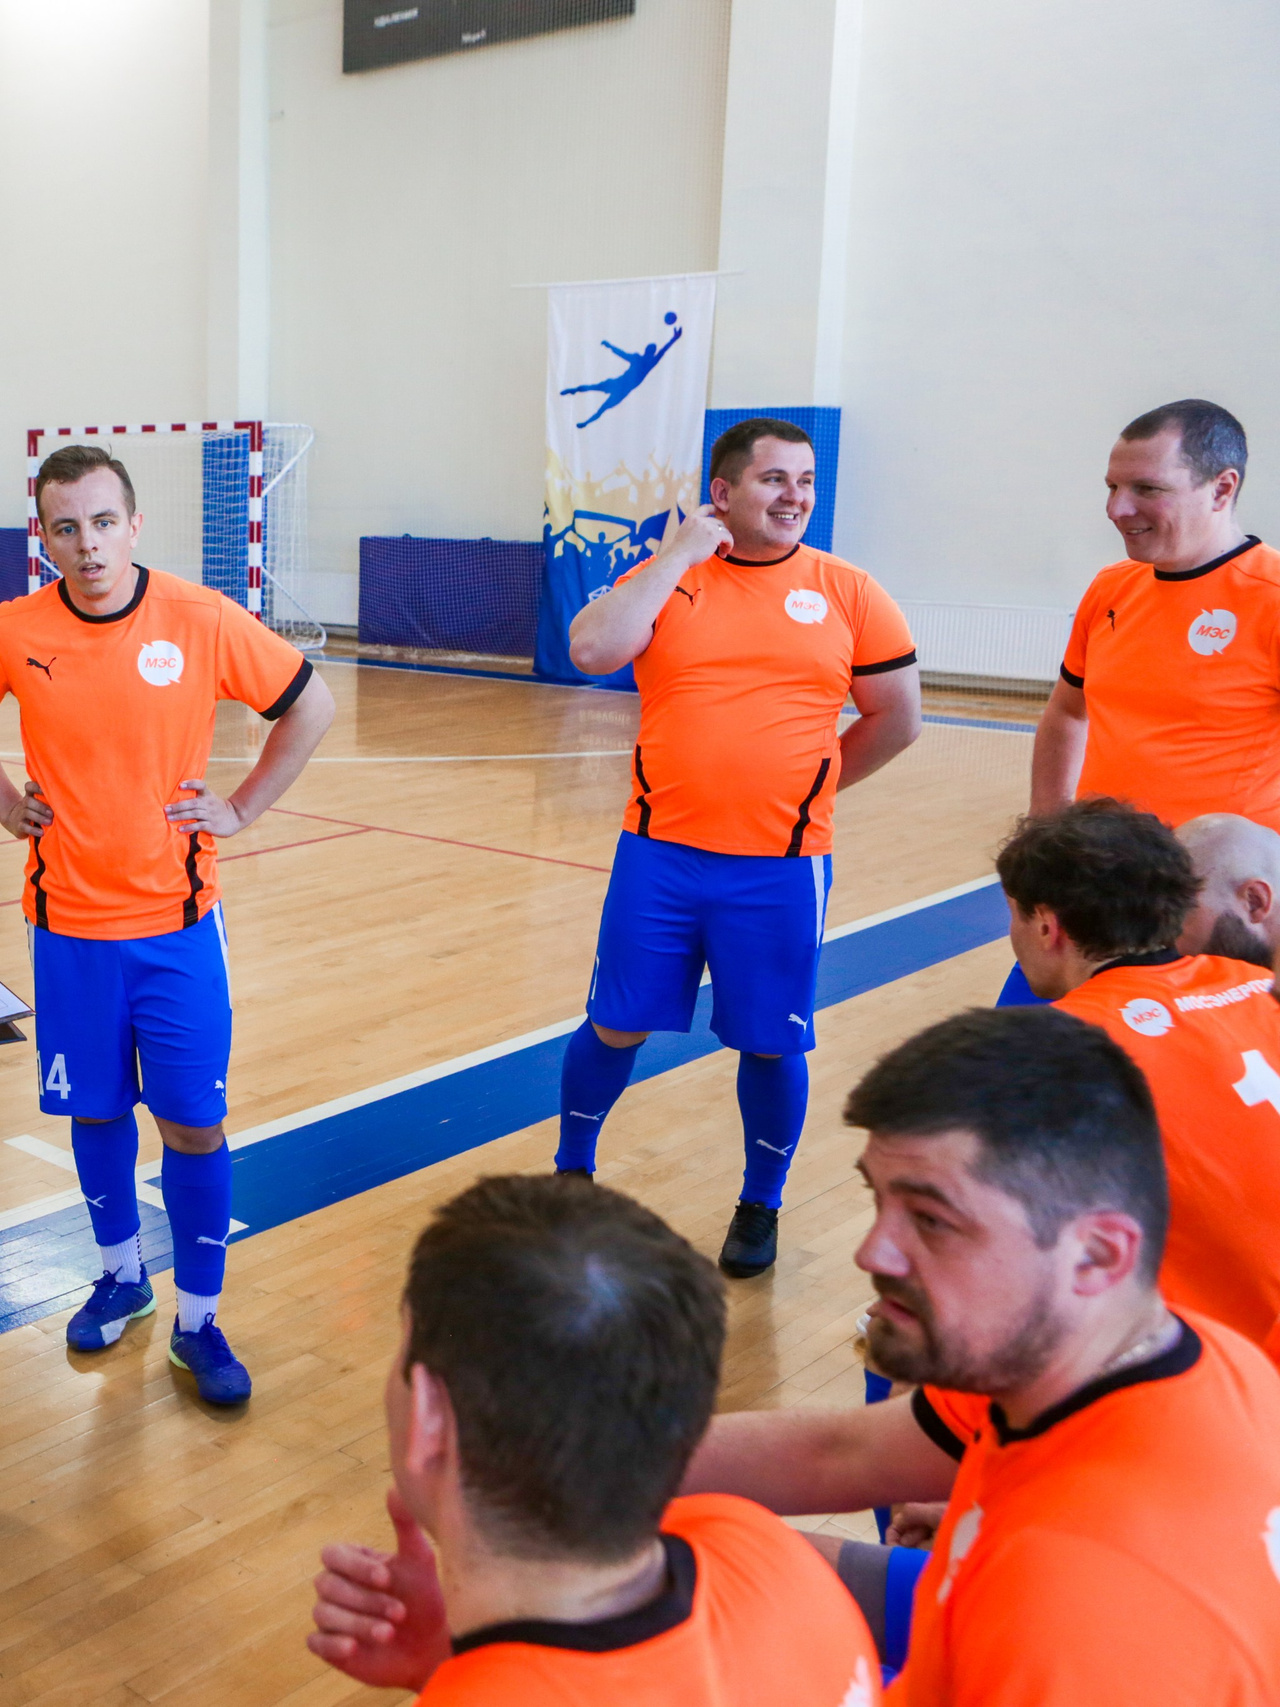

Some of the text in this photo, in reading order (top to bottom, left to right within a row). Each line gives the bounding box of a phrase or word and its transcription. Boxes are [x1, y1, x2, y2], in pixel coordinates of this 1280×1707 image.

[790, 600, 822, 612] МЭС
[1195, 624, 1231, 640] МЭС
[145, 657, 177, 669] МЭС
[1131, 1007, 1162, 1025] МЭС
